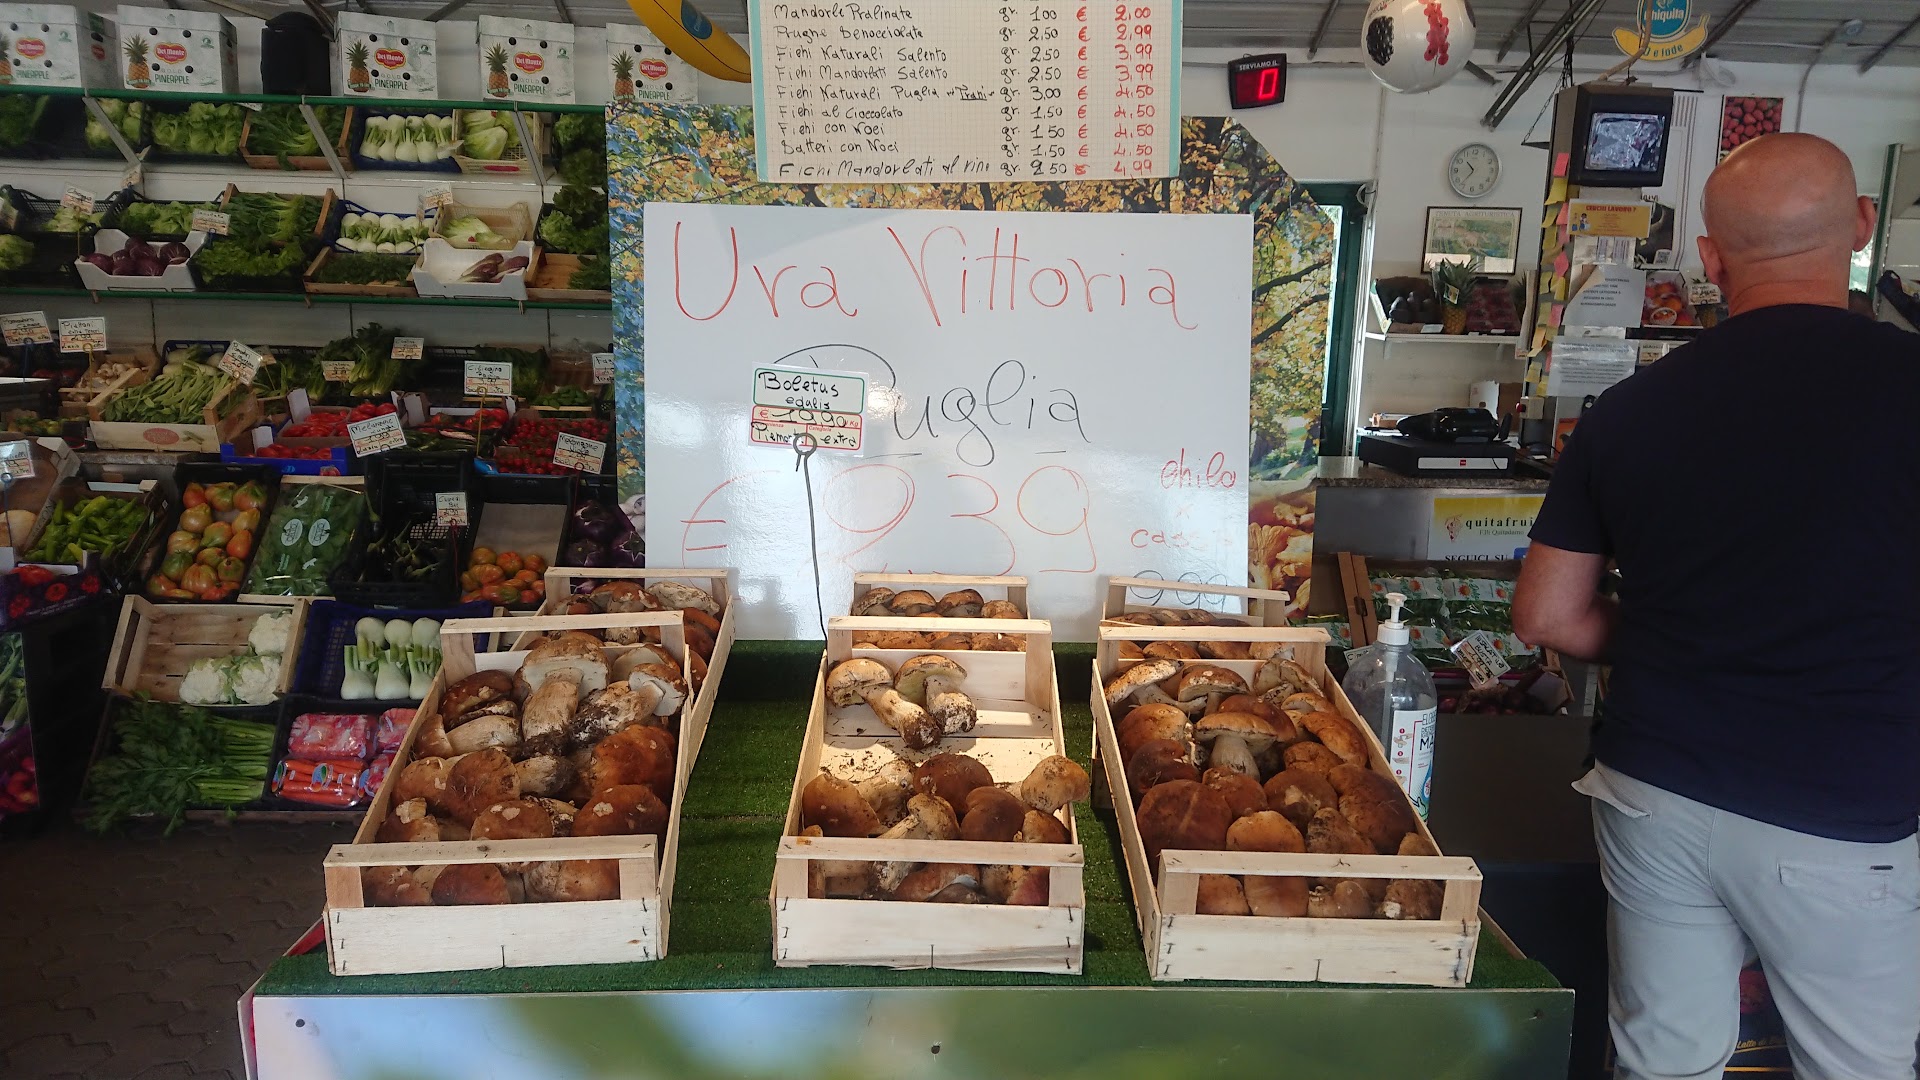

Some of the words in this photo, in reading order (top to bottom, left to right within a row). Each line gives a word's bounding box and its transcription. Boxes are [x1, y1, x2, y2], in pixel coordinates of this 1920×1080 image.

[774, 4, 844, 19] Mandorle
[846, 3, 912, 21] Pralinate
[1115, 5, 1151, 20] 2,00
[1028, 26, 1058, 41] 2,50
[1116, 23, 1152, 40] 2,99
[820, 45, 883, 61] Naturali
[897, 48, 946, 62] Salento
[1115, 44, 1152, 61] 3,99
[1661, 45, 1683, 57] lode
[16, 70, 50, 79] PINEAPPLE
[897, 66, 947, 80] Salento
[1027, 66, 1061, 82] 2,50
[1115, 64, 1153, 81] 3,99
[1239, 60, 1271, 71] SERVIAMO
[155, 73, 190, 84] PINEAPPLE
[375, 79, 409, 90] PINEAPPLE
[1258, 68, 1279, 100] 0
[514, 83, 546, 95] PINEAPPLE
[639, 90, 670, 101] PINEAPPLE
[820, 84, 881, 102] Naturali
[891, 86, 939, 102] Puglia
[1030, 86, 1061, 101] 3,00
[1116, 84, 1153, 98] 4,50
[1030, 106, 1062, 120] 1,50
[1114, 105, 1155, 118] 4,50
[1114, 123, 1153, 138] 4,50
[840, 143, 862, 152] con
[865, 139, 899, 154] Noci
[1031, 144, 1065, 157] 1,50
[1113, 143, 1153, 157] 4,50
[779, 163, 830, 177] Fichi
[837, 158, 934, 176] Mandorlati
[887, 225, 1199, 331] Vittoria
[758, 371, 840, 397] Boletus
[759, 409, 769, 418] €
[772, 408, 849, 428] 19,90
[820, 432, 857, 447] extra
